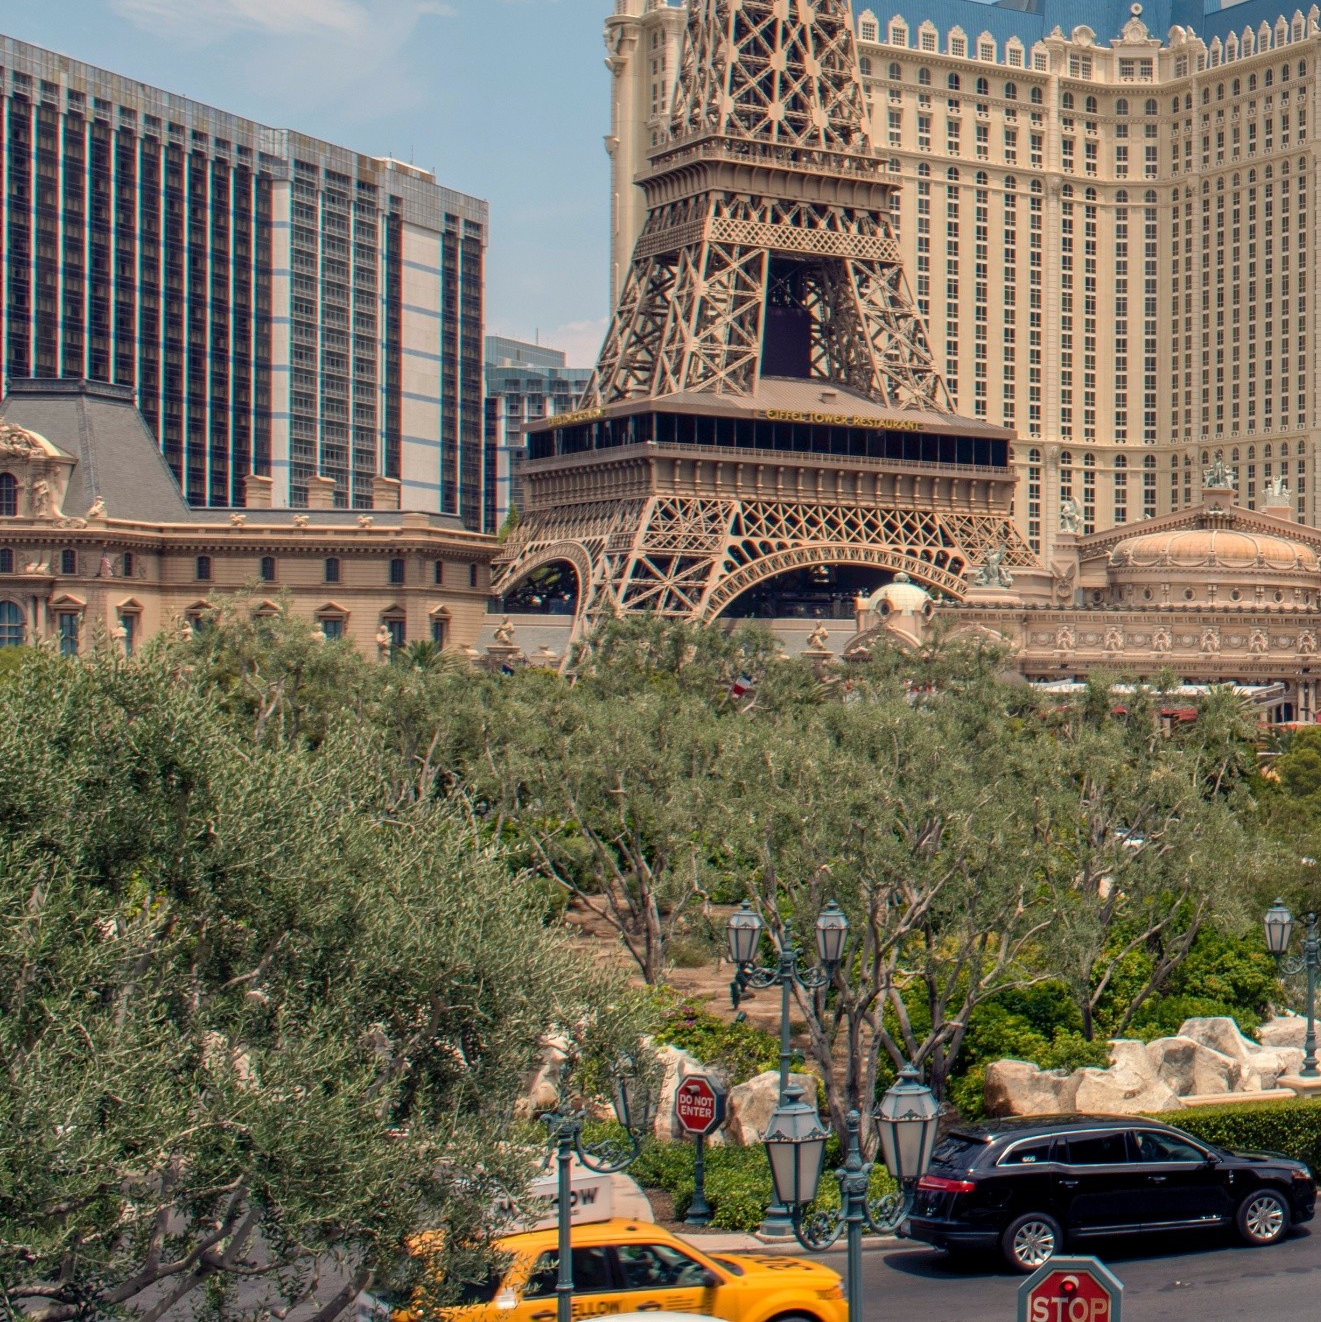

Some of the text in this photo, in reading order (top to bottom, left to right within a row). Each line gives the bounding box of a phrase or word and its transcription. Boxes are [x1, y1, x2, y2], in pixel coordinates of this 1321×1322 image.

[766, 408, 923, 430] EIFFEL TOWER RESTAURANT
[680, 1094, 713, 1108] DO NOT
[681, 1105, 712, 1118] ENTER
[571, 1300, 622, 1319] ELLOW
[1032, 1296, 1108, 1322] STOP
